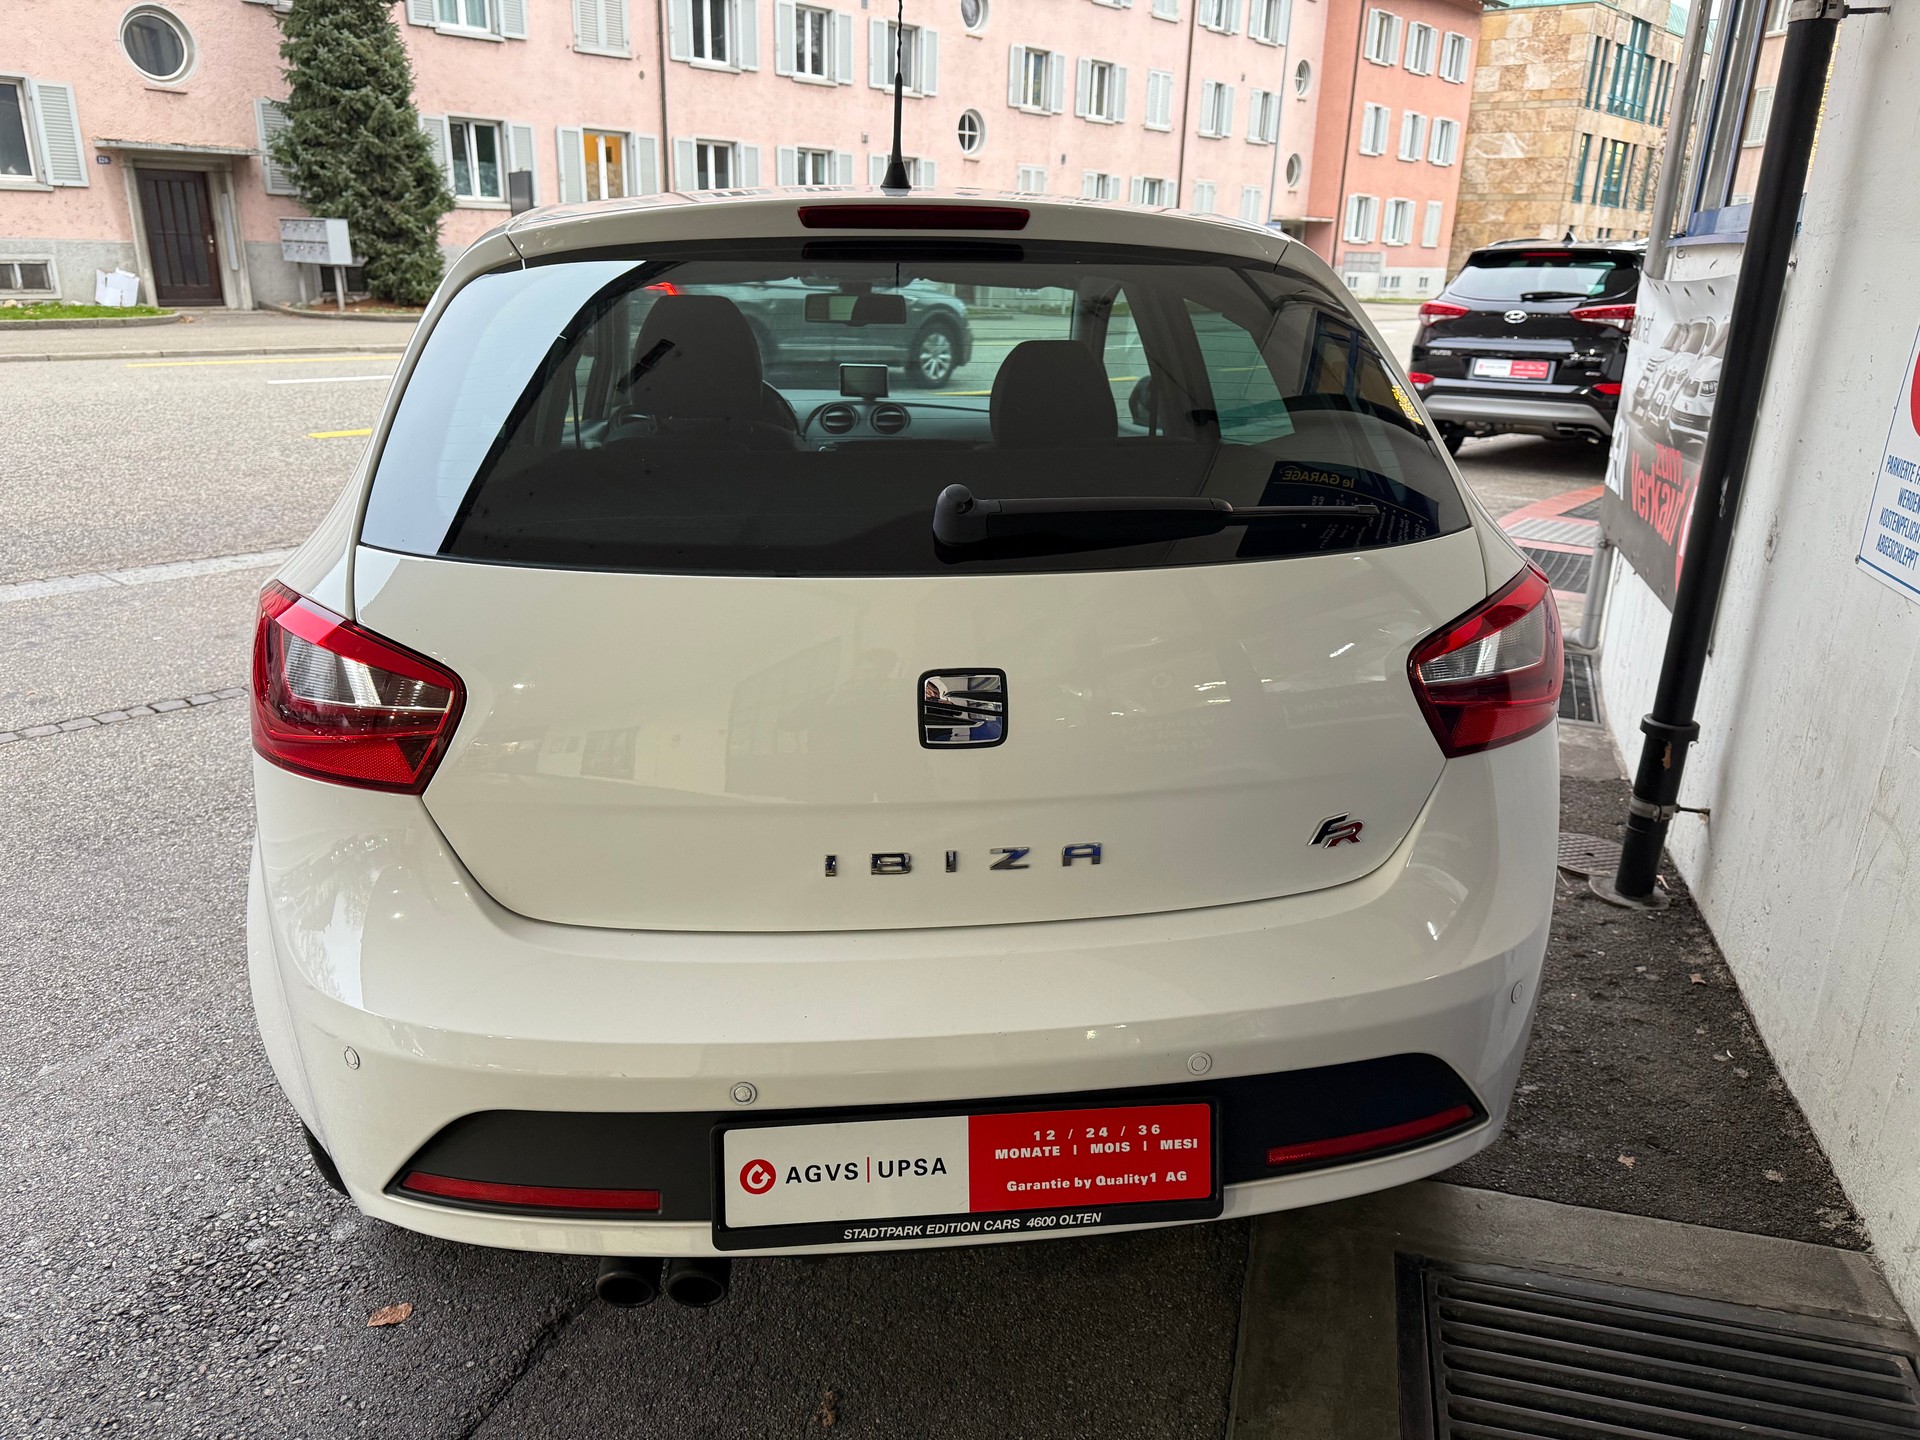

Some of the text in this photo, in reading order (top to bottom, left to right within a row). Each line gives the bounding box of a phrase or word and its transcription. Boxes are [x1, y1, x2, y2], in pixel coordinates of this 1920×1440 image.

[1655, 442, 1683, 486] zum
[1885, 454, 1917, 483] PARKIERTE
[1632, 449, 1690, 546] Verkauf
[1876, 533, 1919, 570] ABGESCHLEPPT
[1307, 811, 1364, 849] FR
[825, 842, 1102, 877] IBIZA
[1034, 1130, 1056, 1141] 12
[1085, 1127, 1108, 1138] 24
[1138, 1124, 1161, 1135] 36
[995, 1146, 1061, 1160] MONATE
[1090, 1142, 1131, 1154] MOIS
[1160, 1138, 1198, 1150] MESI
[785, 1157, 948, 1184] AGVS UPSA
[1006, 1170, 1188, 1192] Garantie by Quality1 AG
[843, 1212, 1102, 1240] STADTPARK EDITION CARS 4600 OLTEN
